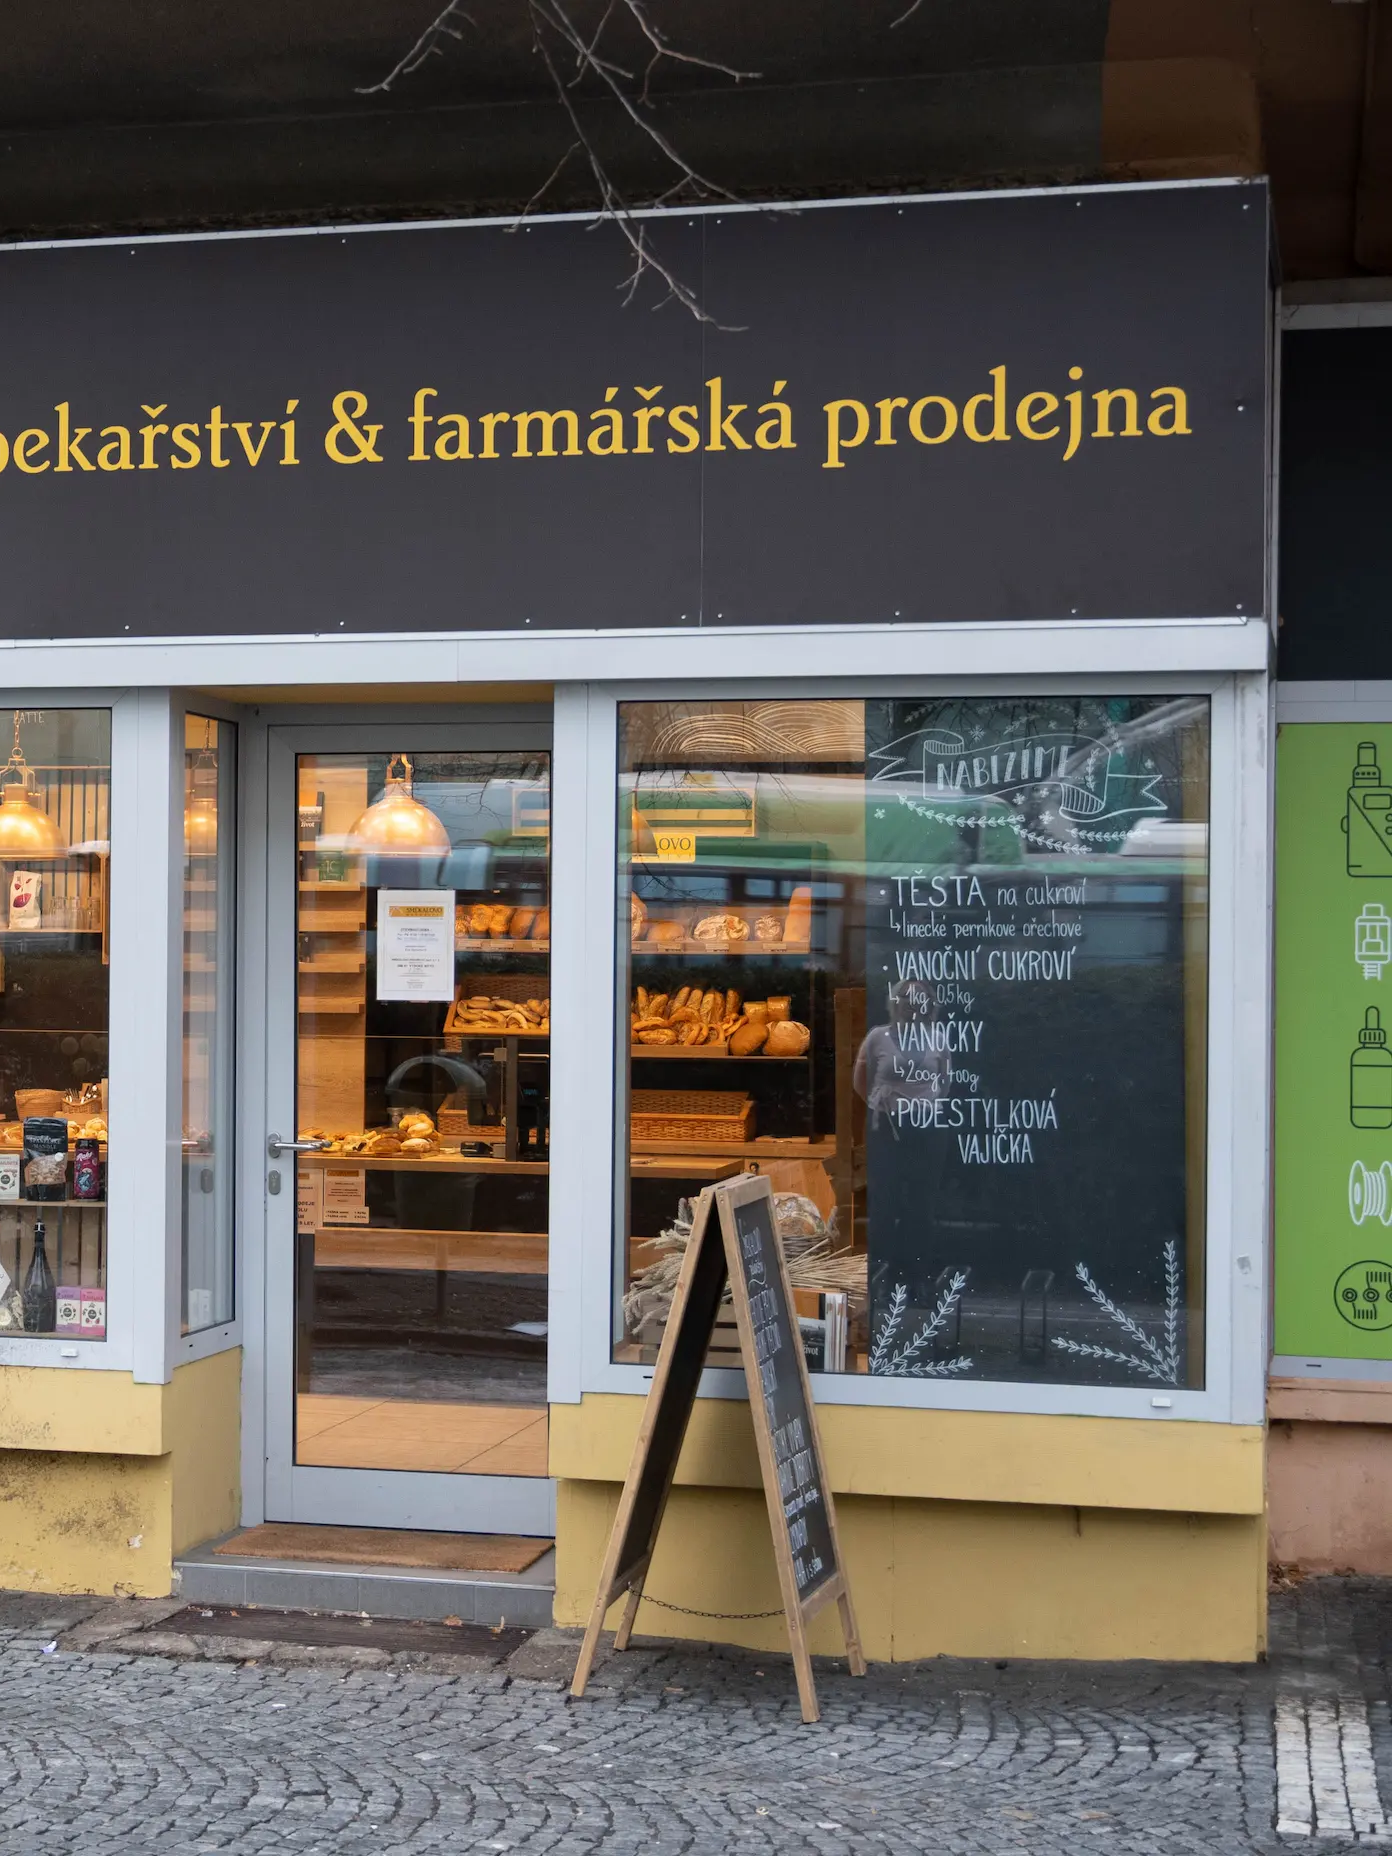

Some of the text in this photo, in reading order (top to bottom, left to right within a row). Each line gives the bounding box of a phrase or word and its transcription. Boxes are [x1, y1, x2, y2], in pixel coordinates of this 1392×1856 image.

[323, 390, 385, 465] &
[407, 377, 797, 461] farmářská
[821, 364, 1193, 468] prodejna
[654, 837, 691, 851] OVO
[890, 868, 1088, 907] TĚSTA na cukroví
[902, 908, 1083, 939] linecké perníkové ořechové
[987, 944, 1077, 981] CUKROVÍ
[896, 1012, 984, 1053] VÁNOČKY
[895, 1087, 1058, 1129] PODESTYLKOVÁ
[958, 1127, 1034, 1164] VAJÍČKA
